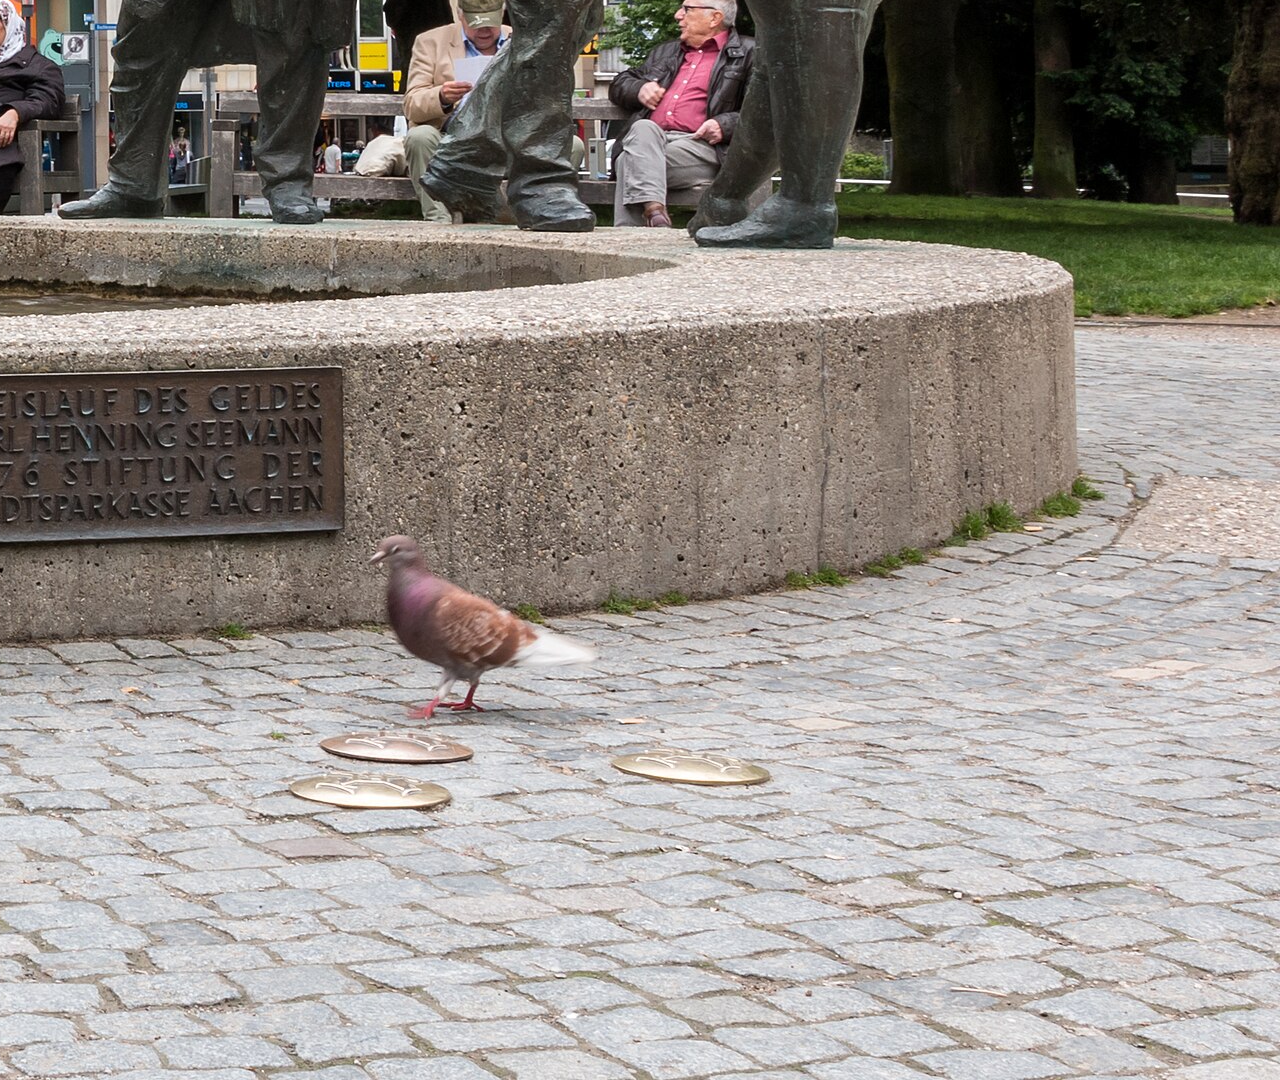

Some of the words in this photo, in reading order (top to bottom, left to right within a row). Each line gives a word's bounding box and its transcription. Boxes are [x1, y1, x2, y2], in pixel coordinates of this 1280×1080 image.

[134, 386, 190, 415] DES
[208, 382, 322, 412] GELDES
[31, 422, 179, 452] HENNING
[185, 417, 323, 448] SEEMANN
[63, 455, 237, 488] STIFTUNG
[263, 451, 323, 481] DER
[203, 483, 323, 516] AACHEN
